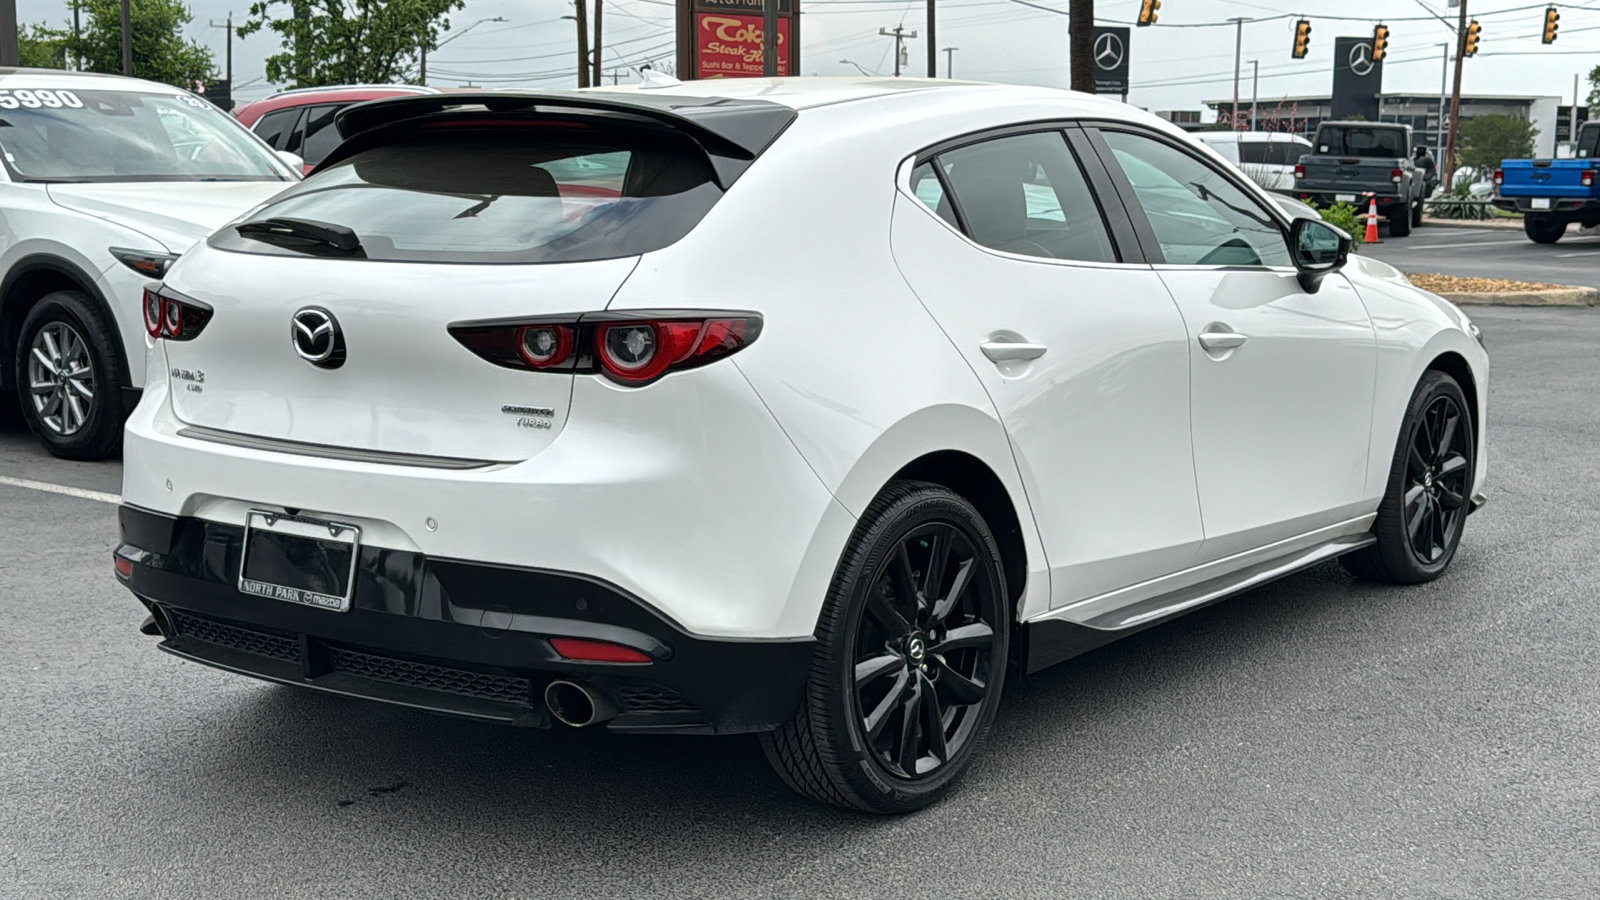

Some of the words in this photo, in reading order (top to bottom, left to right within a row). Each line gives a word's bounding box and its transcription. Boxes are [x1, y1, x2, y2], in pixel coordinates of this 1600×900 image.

[702, 42, 746, 56] Steak
[702, 61, 720, 69] Sushi
[516, 417, 552, 430] TURBO
[243, 581, 273, 596] NORTH
[275, 588, 299, 601] PARK
[312, 594, 340, 608] mazda
